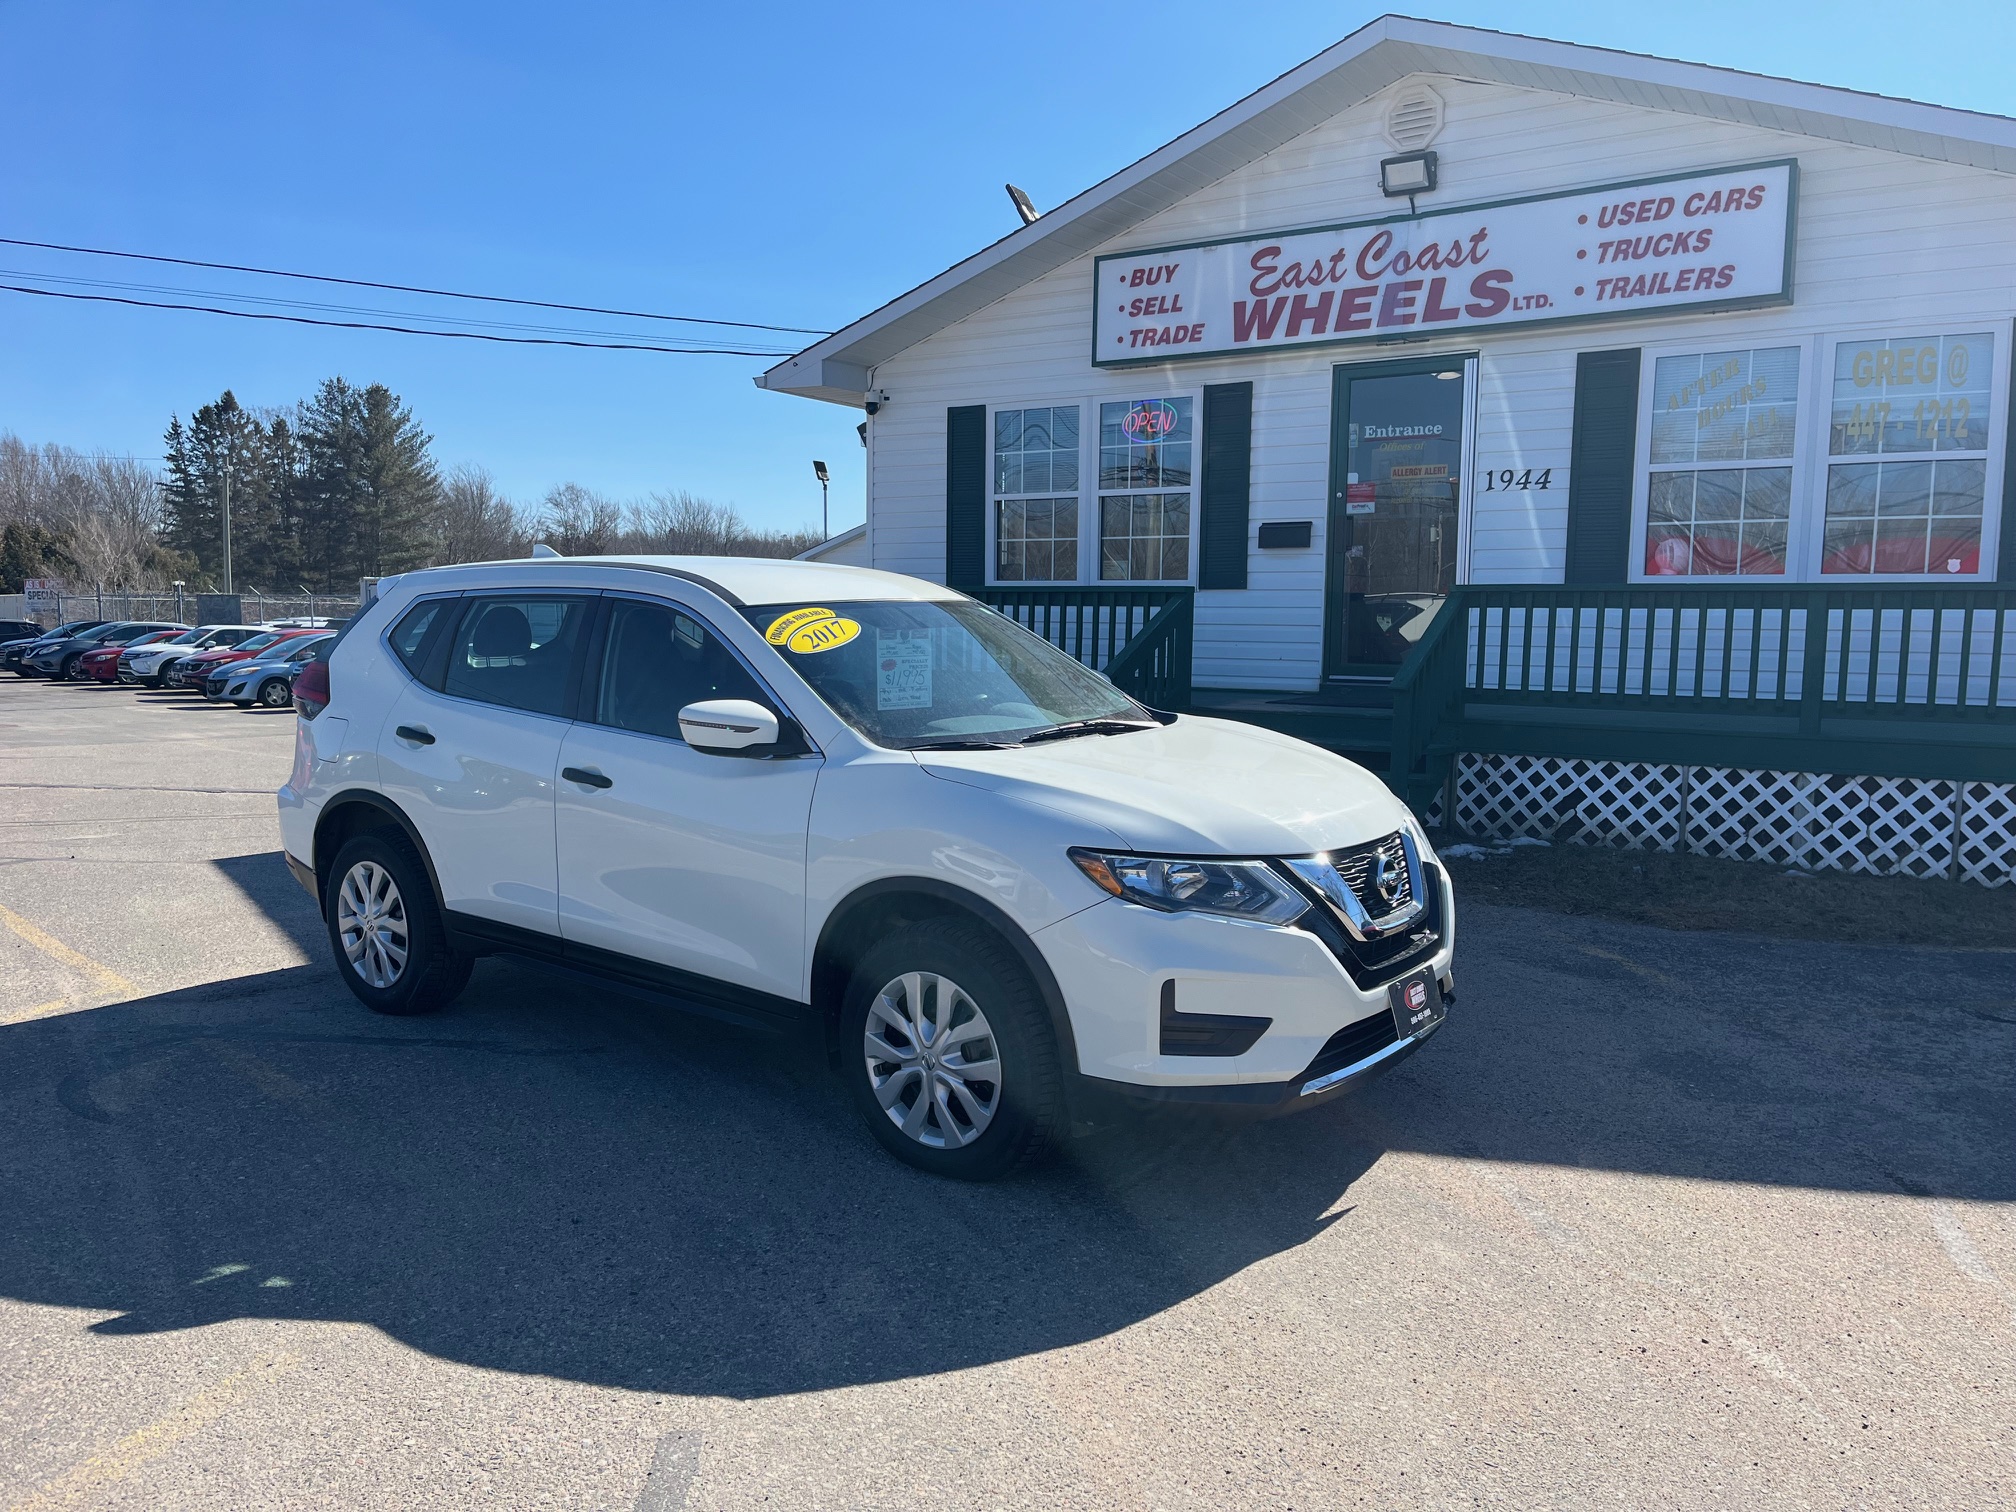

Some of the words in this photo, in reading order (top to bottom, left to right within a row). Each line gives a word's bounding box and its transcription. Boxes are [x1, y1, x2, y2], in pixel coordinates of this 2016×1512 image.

[1597, 196, 1675, 229] USED
[1683, 185, 1766, 218] CARS
[1597, 228, 1713, 265] TRUCKS
[1129, 263, 1180, 288] BUY
[1249, 245, 1348, 298] East
[1355, 227, 1490, 281] Coast
[1596, 264, 1736, 301] TRAILERS
[1128, 293, 1184, 317] SELL
[1233, 269, 1514, 343] WHEELS
[1512, 293, 1554, 311] LTD.
[1129, 322, 1206, 348] TRADE
[1852, 346, 1938, 388] GREG
[1666, 358, 1740, 415] AFTER
[1697, 376, 1766, 431] HOURS
[1125, 410, 1172, 432] OPEN
[1364, 424, 1443, 438] Entrance
[1846, 402, 1891, 442] 447
[1913, 397, 1970, 440] 1212
[1380, 442, 1412, 452] Offices
[1392, 467, 1423, 477] ALLERGY
[1424, 466, 1447, 475] ALERT
[1485, 468, 1552, 492] 1944
[792, 609, 827, 621] AVAILABLE
[801, 620, 846, 650] 2017
